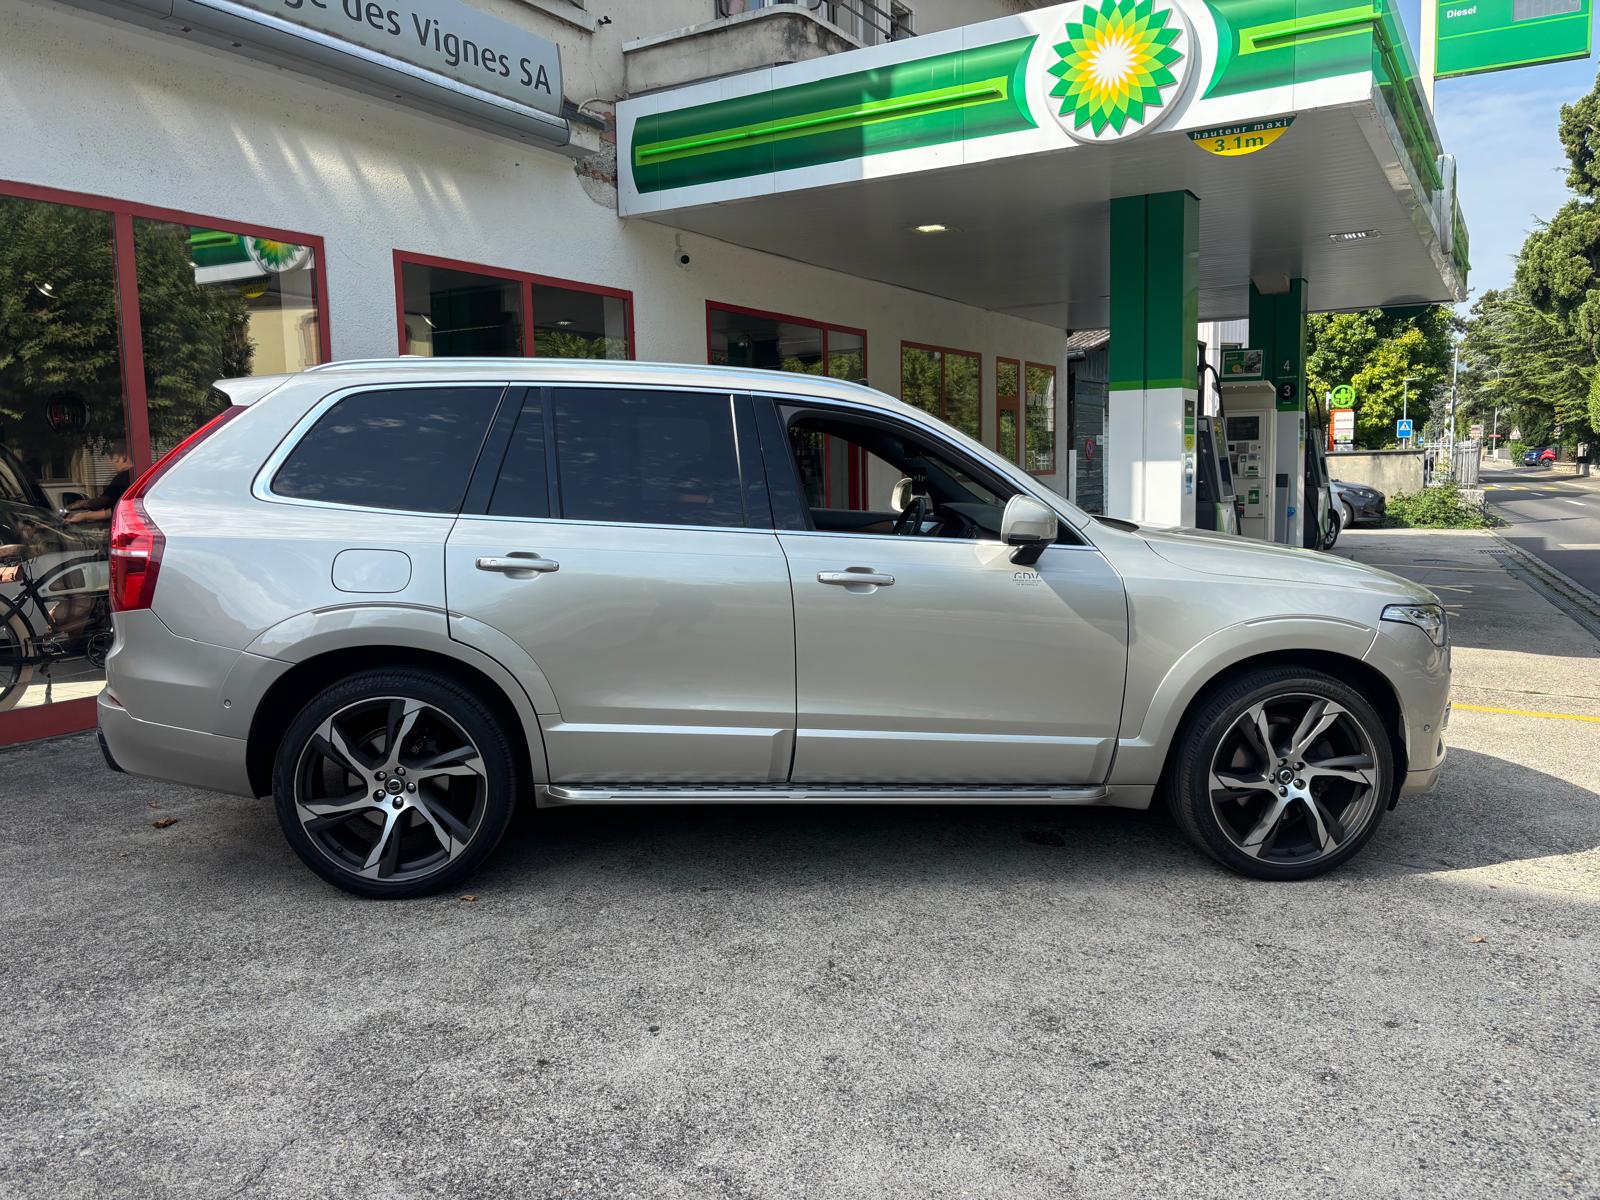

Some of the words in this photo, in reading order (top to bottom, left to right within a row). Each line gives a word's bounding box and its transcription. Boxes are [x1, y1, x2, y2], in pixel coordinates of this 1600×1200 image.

[1446, 5, 1477, 19] Diesel
[342, 0, 401, 36] des
[411, 12, 511, 78] Vignes
[519, 57, 552, 95] SA
[1193, 125, 1248, 140] hauteur
[1253, 117, 1288, 131] maxi
[1213, 135, 1265, 153] 3.1m
[1283, 359, 1291, 371] 4
[1283, 385, 1291, 397] 3
